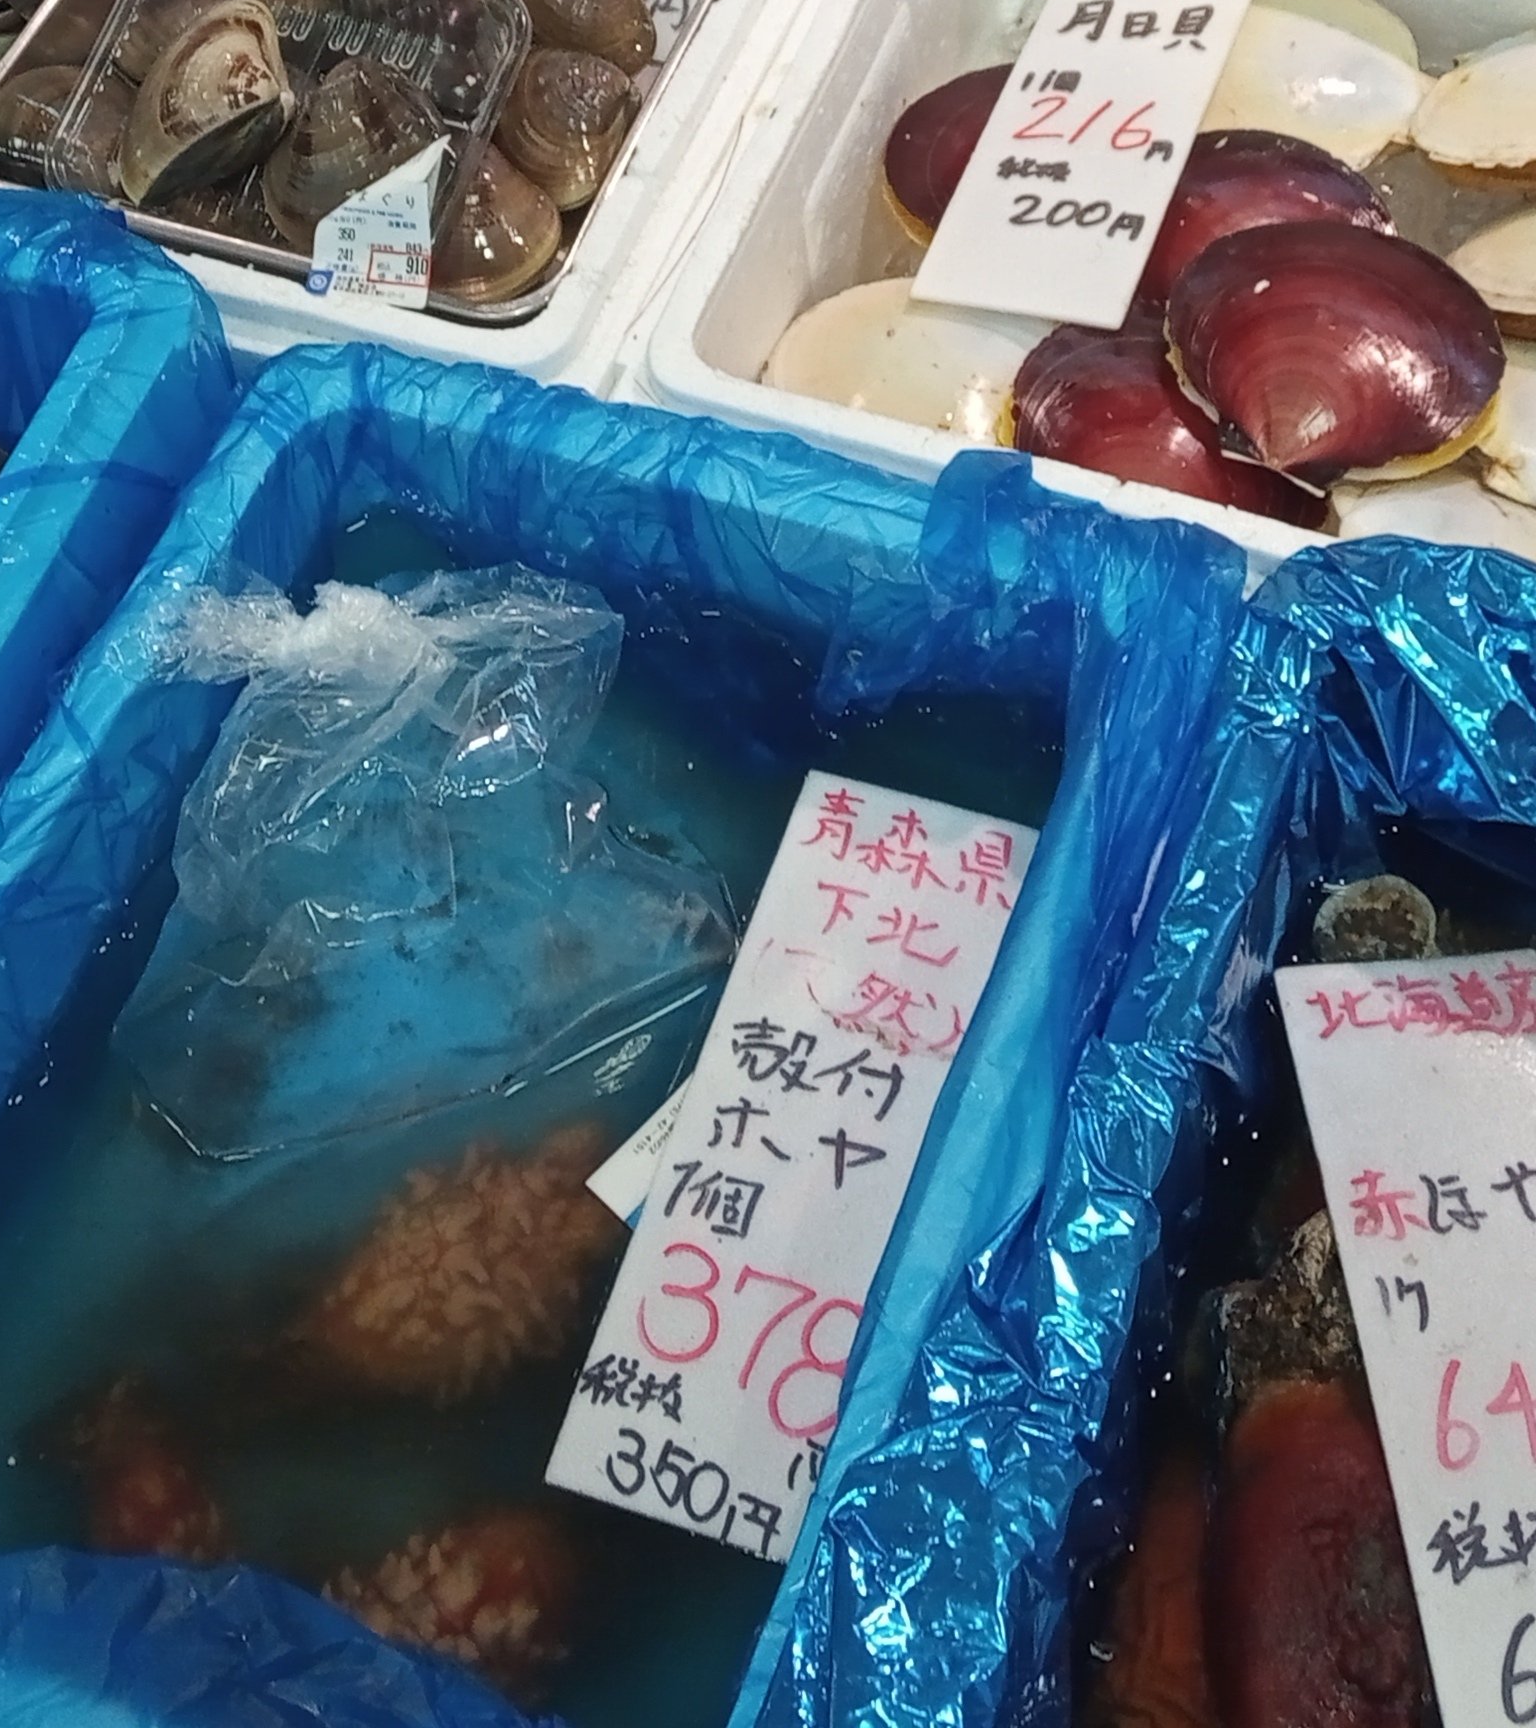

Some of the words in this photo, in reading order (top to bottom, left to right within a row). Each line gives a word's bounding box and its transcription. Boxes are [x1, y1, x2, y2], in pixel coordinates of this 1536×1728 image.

[1008, 194, 1146, 242] 200円
[802, 788, 1016, 911] 青森県
[818, 882, 961, 968] 下北
